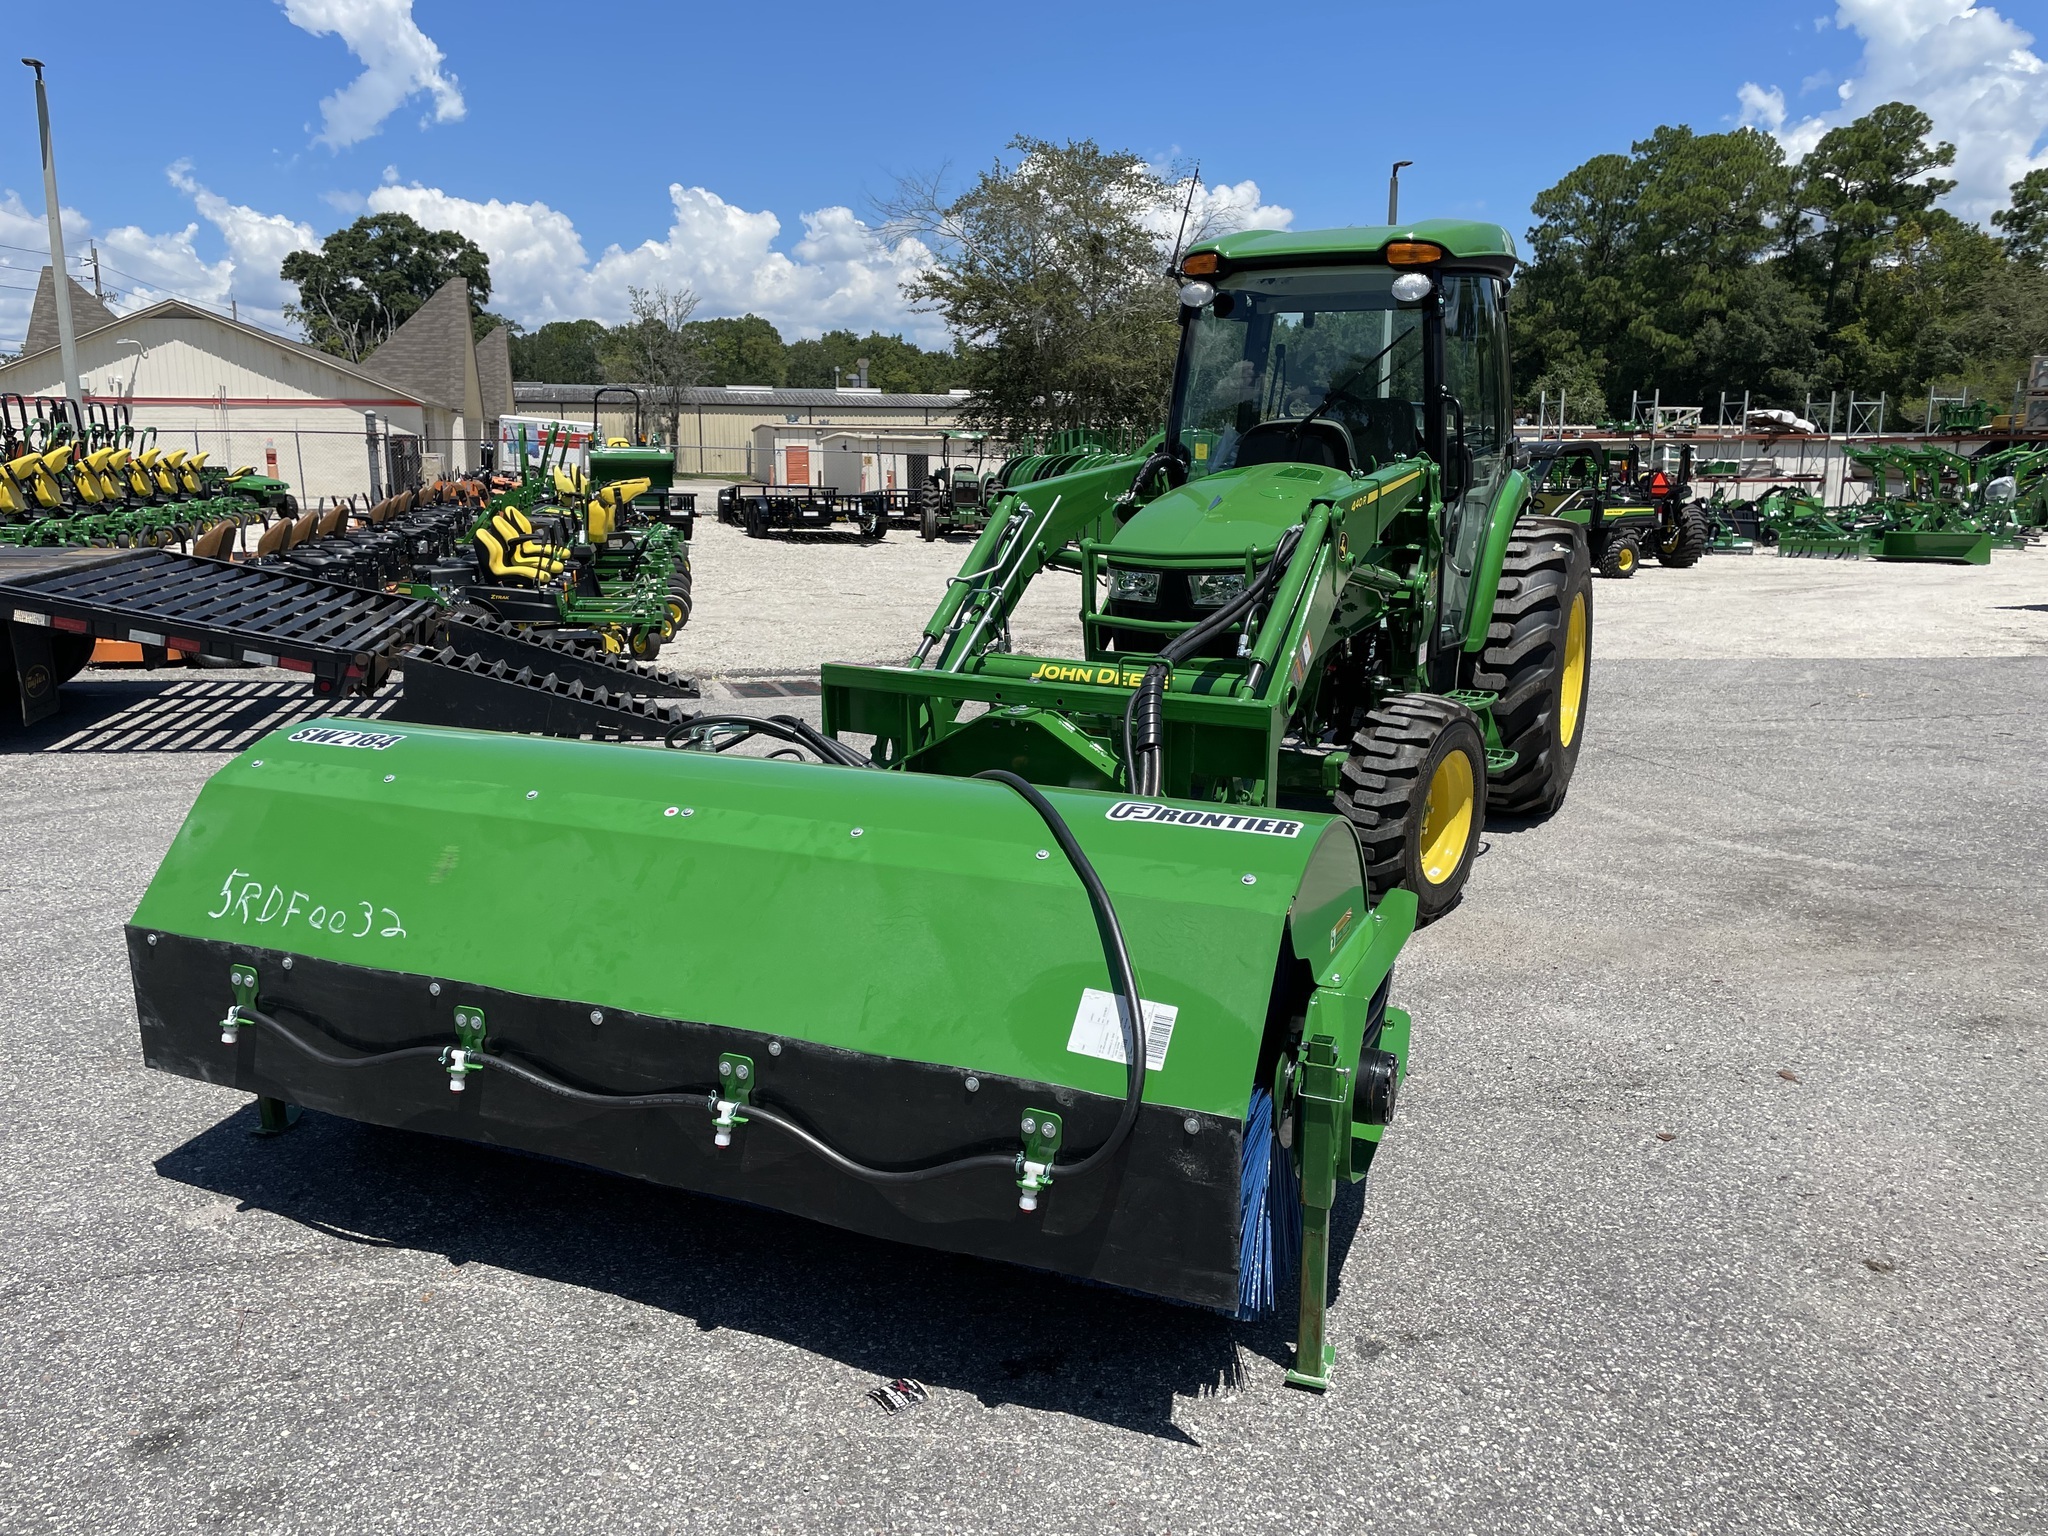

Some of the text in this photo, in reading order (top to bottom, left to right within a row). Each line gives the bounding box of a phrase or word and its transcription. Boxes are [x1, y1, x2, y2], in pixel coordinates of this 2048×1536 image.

[1032, 663, 1176, 690] JOHN DEE
[291, 728, 403, 749] SW2184
[1109, 802, 1304, 836] FRONTIER
[208, 868, 407, 939] 5RDF0032
